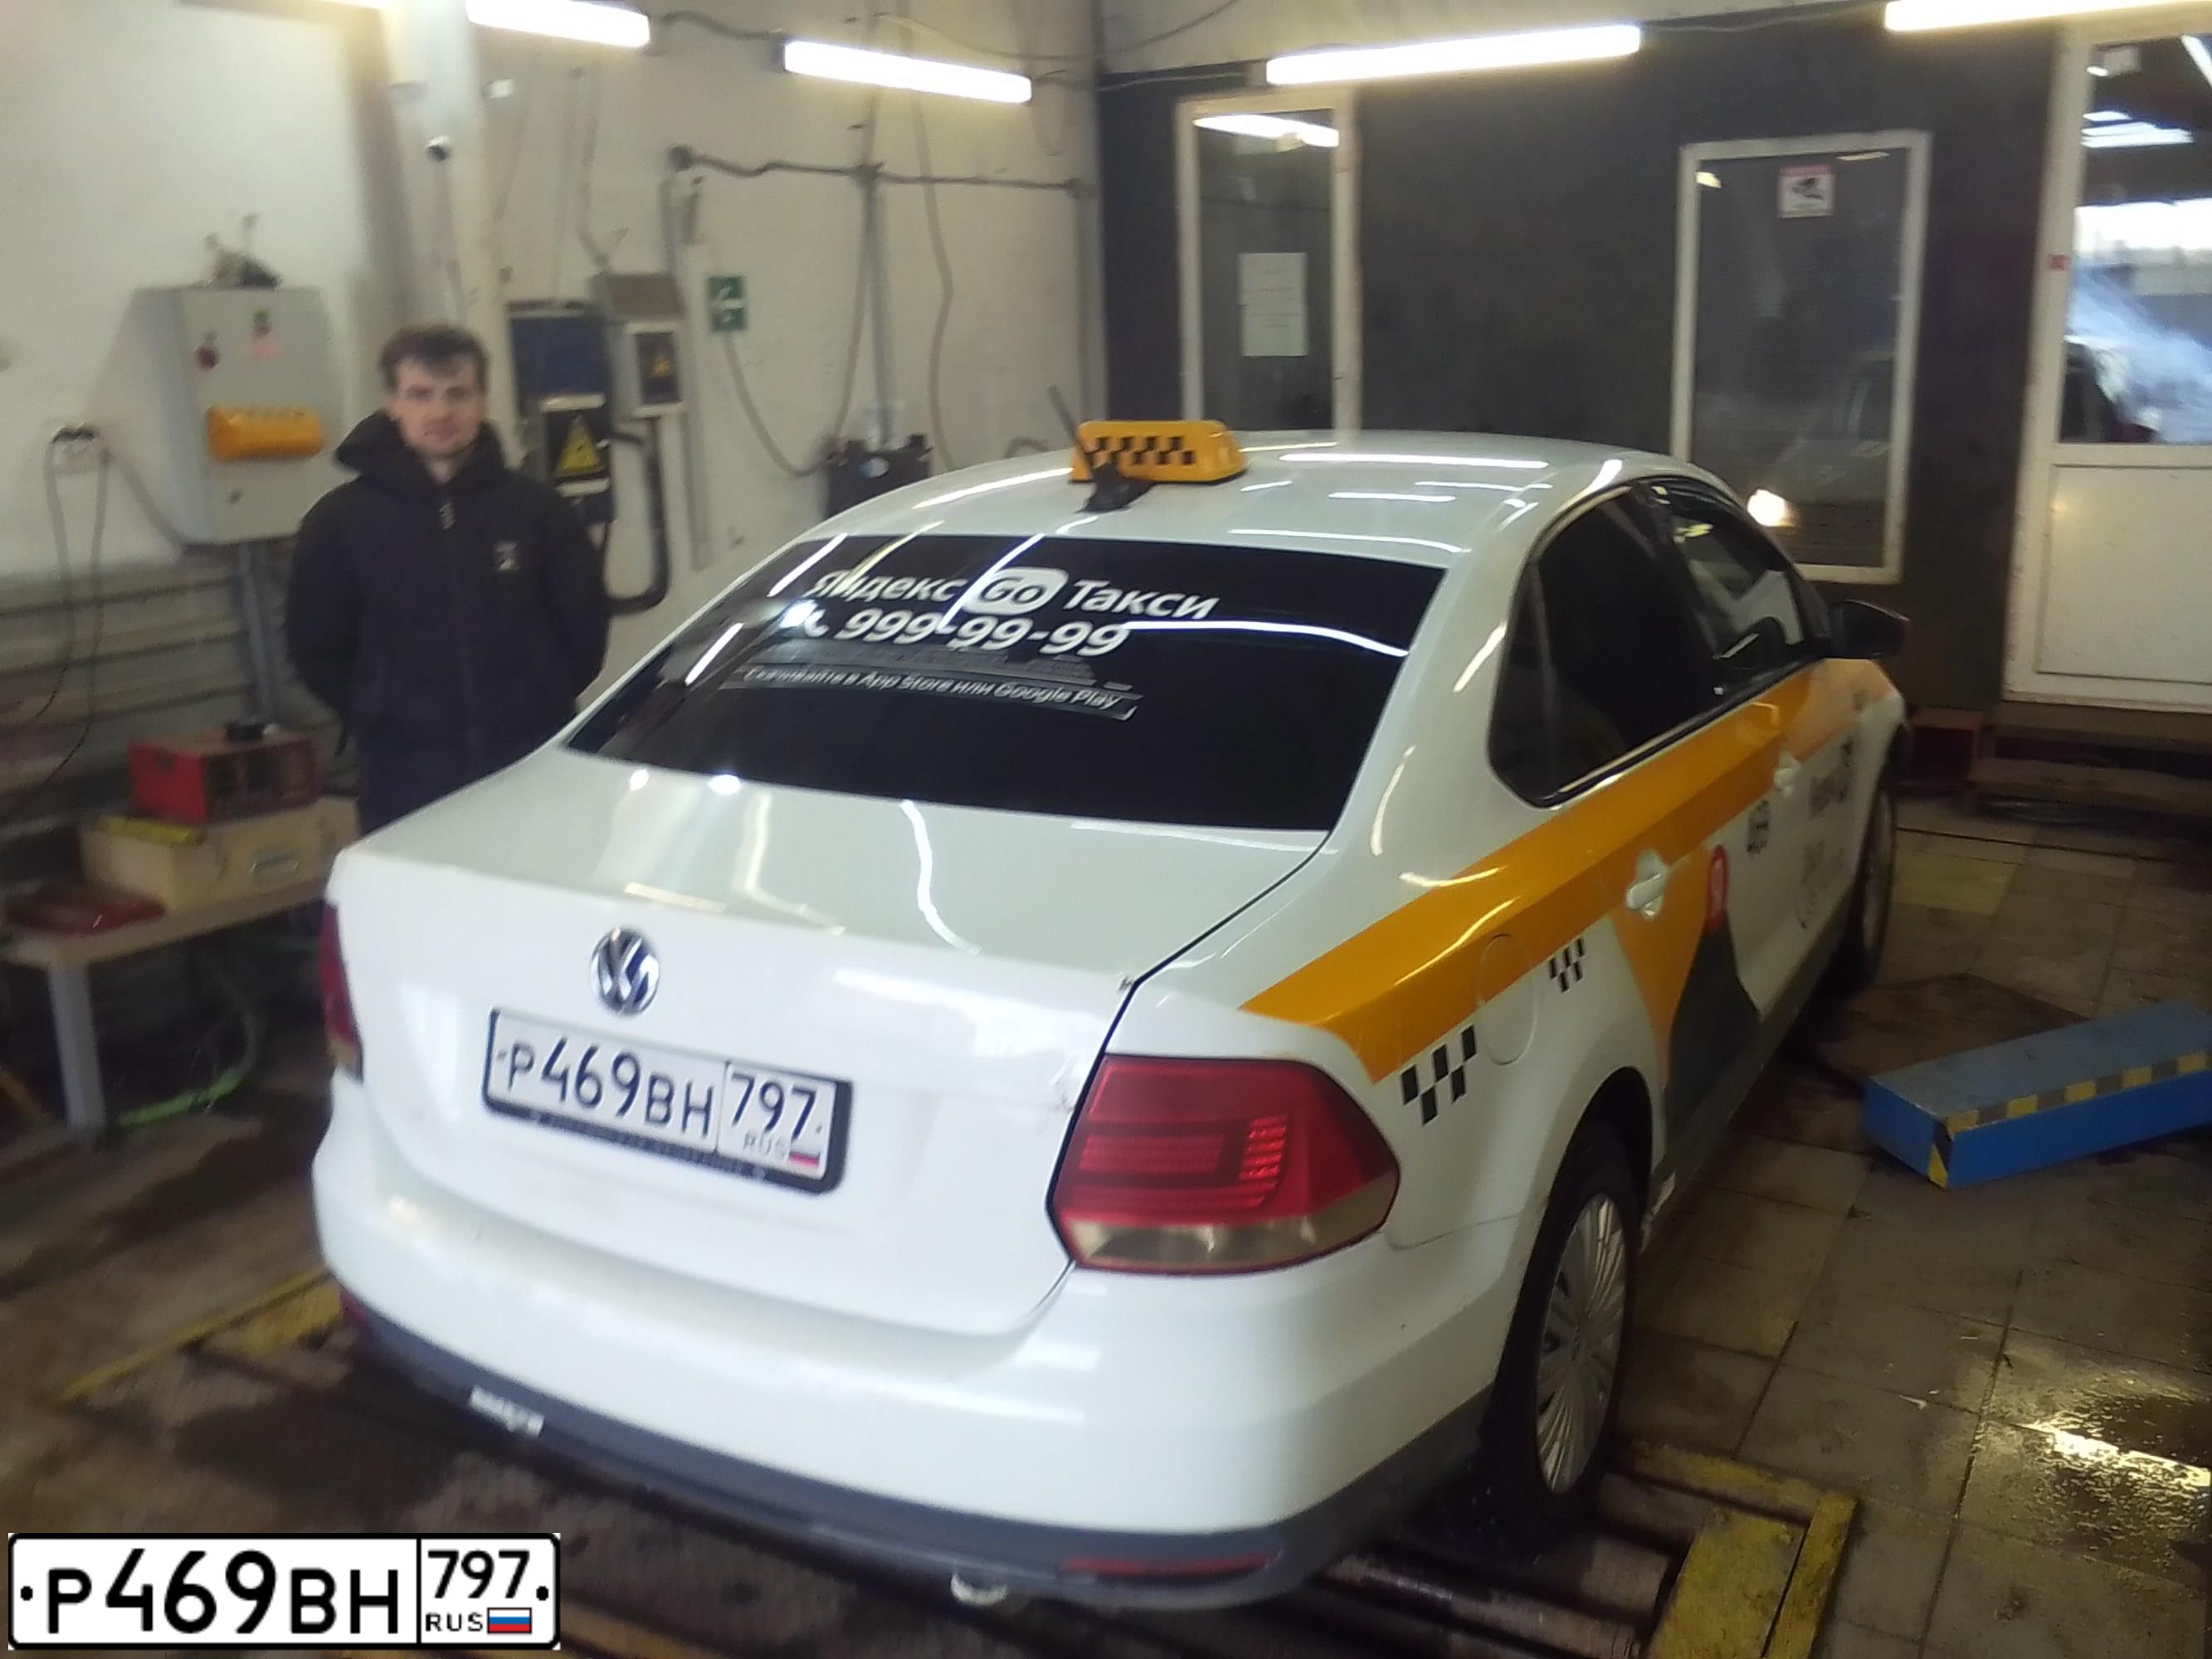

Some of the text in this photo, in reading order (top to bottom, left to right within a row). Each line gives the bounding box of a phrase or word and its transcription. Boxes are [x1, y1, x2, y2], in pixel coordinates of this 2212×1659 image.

[802, 569, 967, 603] Яндекс
[1063, 578, 1220, 620] Такси
[834, 607, 1131, 657] 999-99-99
[855, 670, 901, 690] App
[993, 681, 1074, 704] Google
[1069, 688, 1123, 710] Play
[729, 1073, 817, 1141] 797
